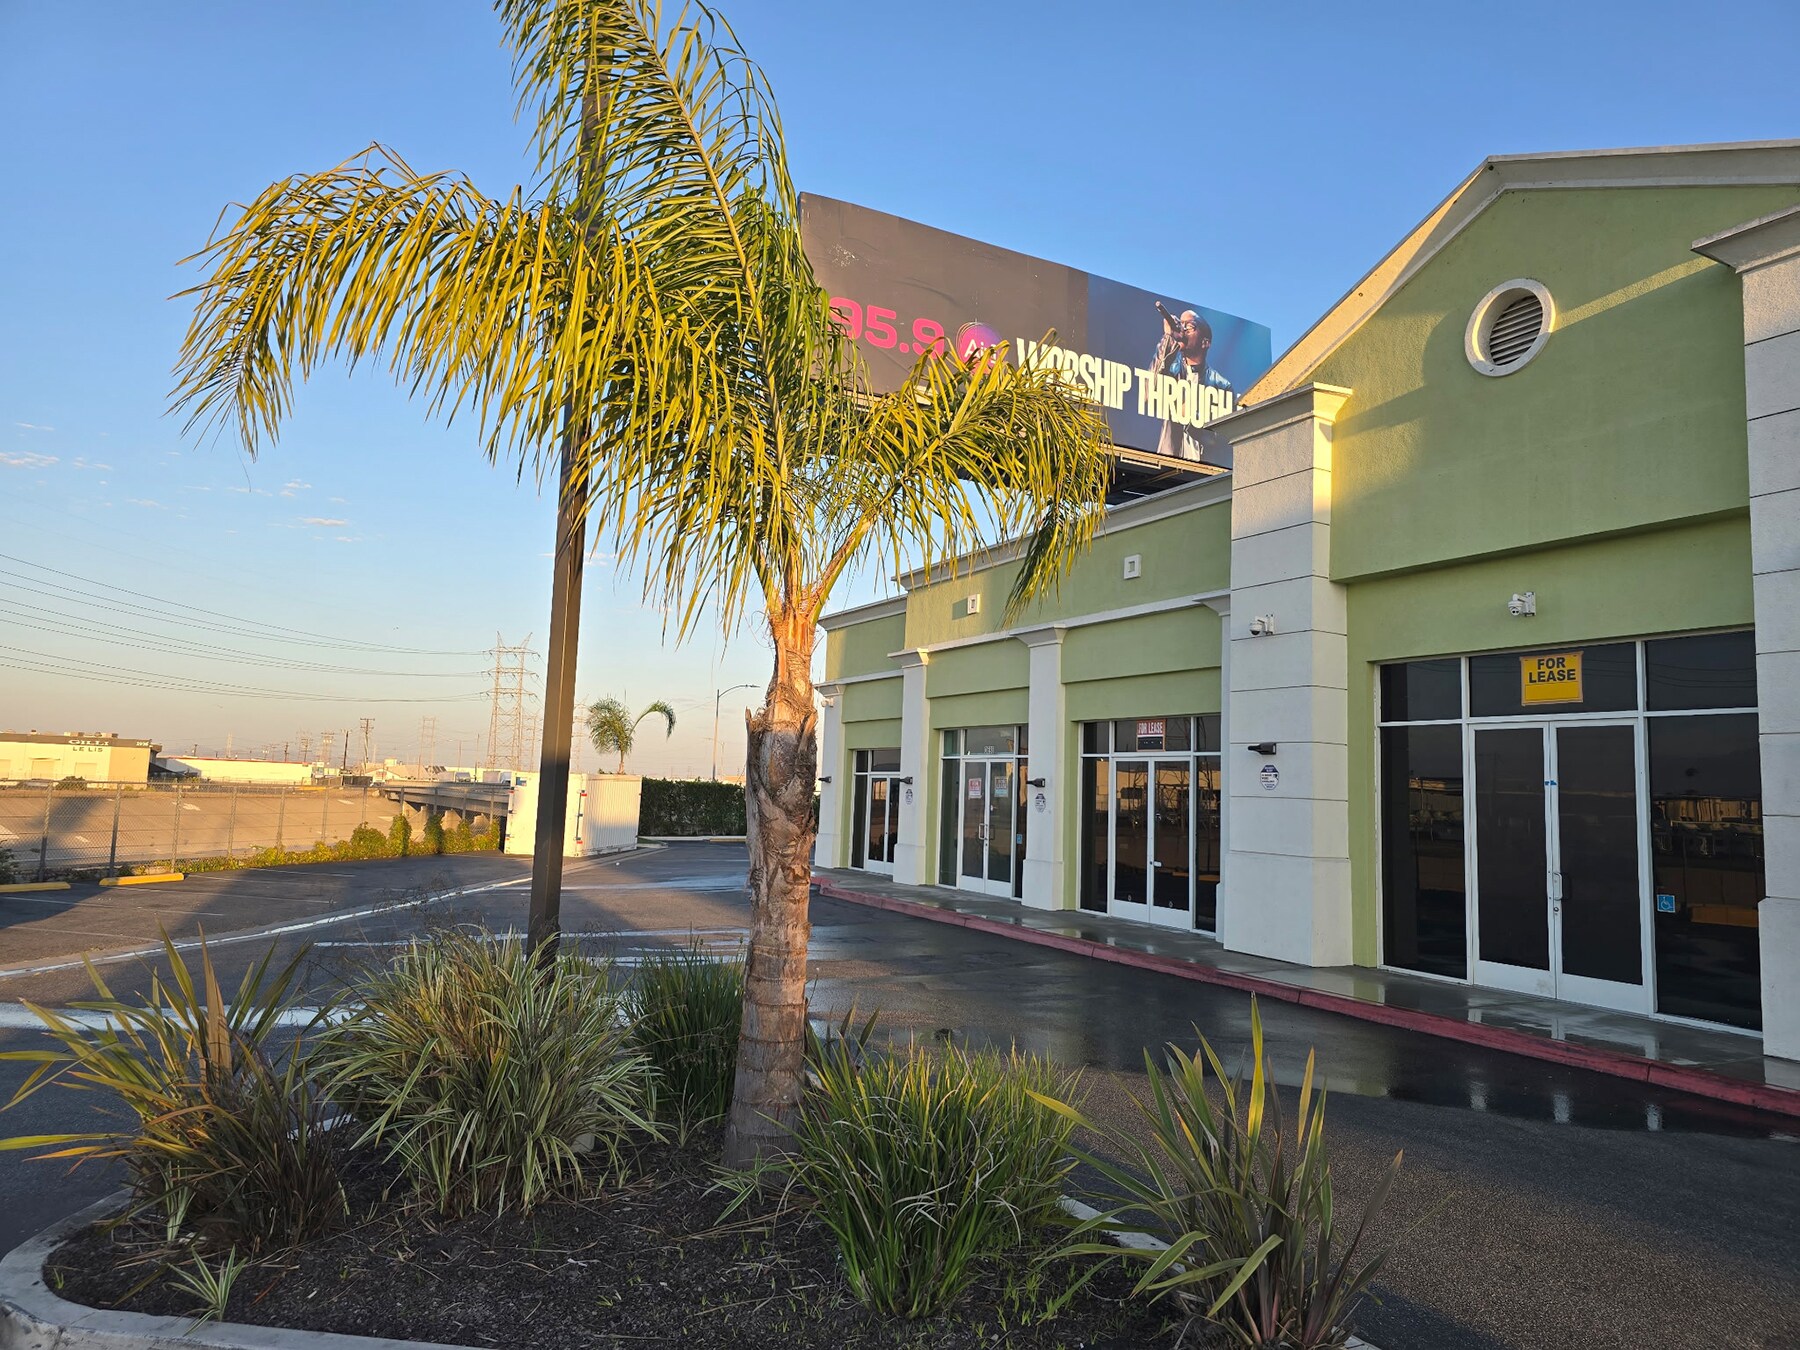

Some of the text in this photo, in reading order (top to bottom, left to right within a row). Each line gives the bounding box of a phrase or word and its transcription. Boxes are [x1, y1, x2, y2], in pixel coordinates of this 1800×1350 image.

[827, 297, 945, 360] 95.9
[1016, 337, 1234, 429] WORSHIP THROUGH
[1537, 657, 1566, 670] FOR
[1528, 669, 1577, 684] LEASE
[1138, 722, 1164, 734] FOR LEASE
